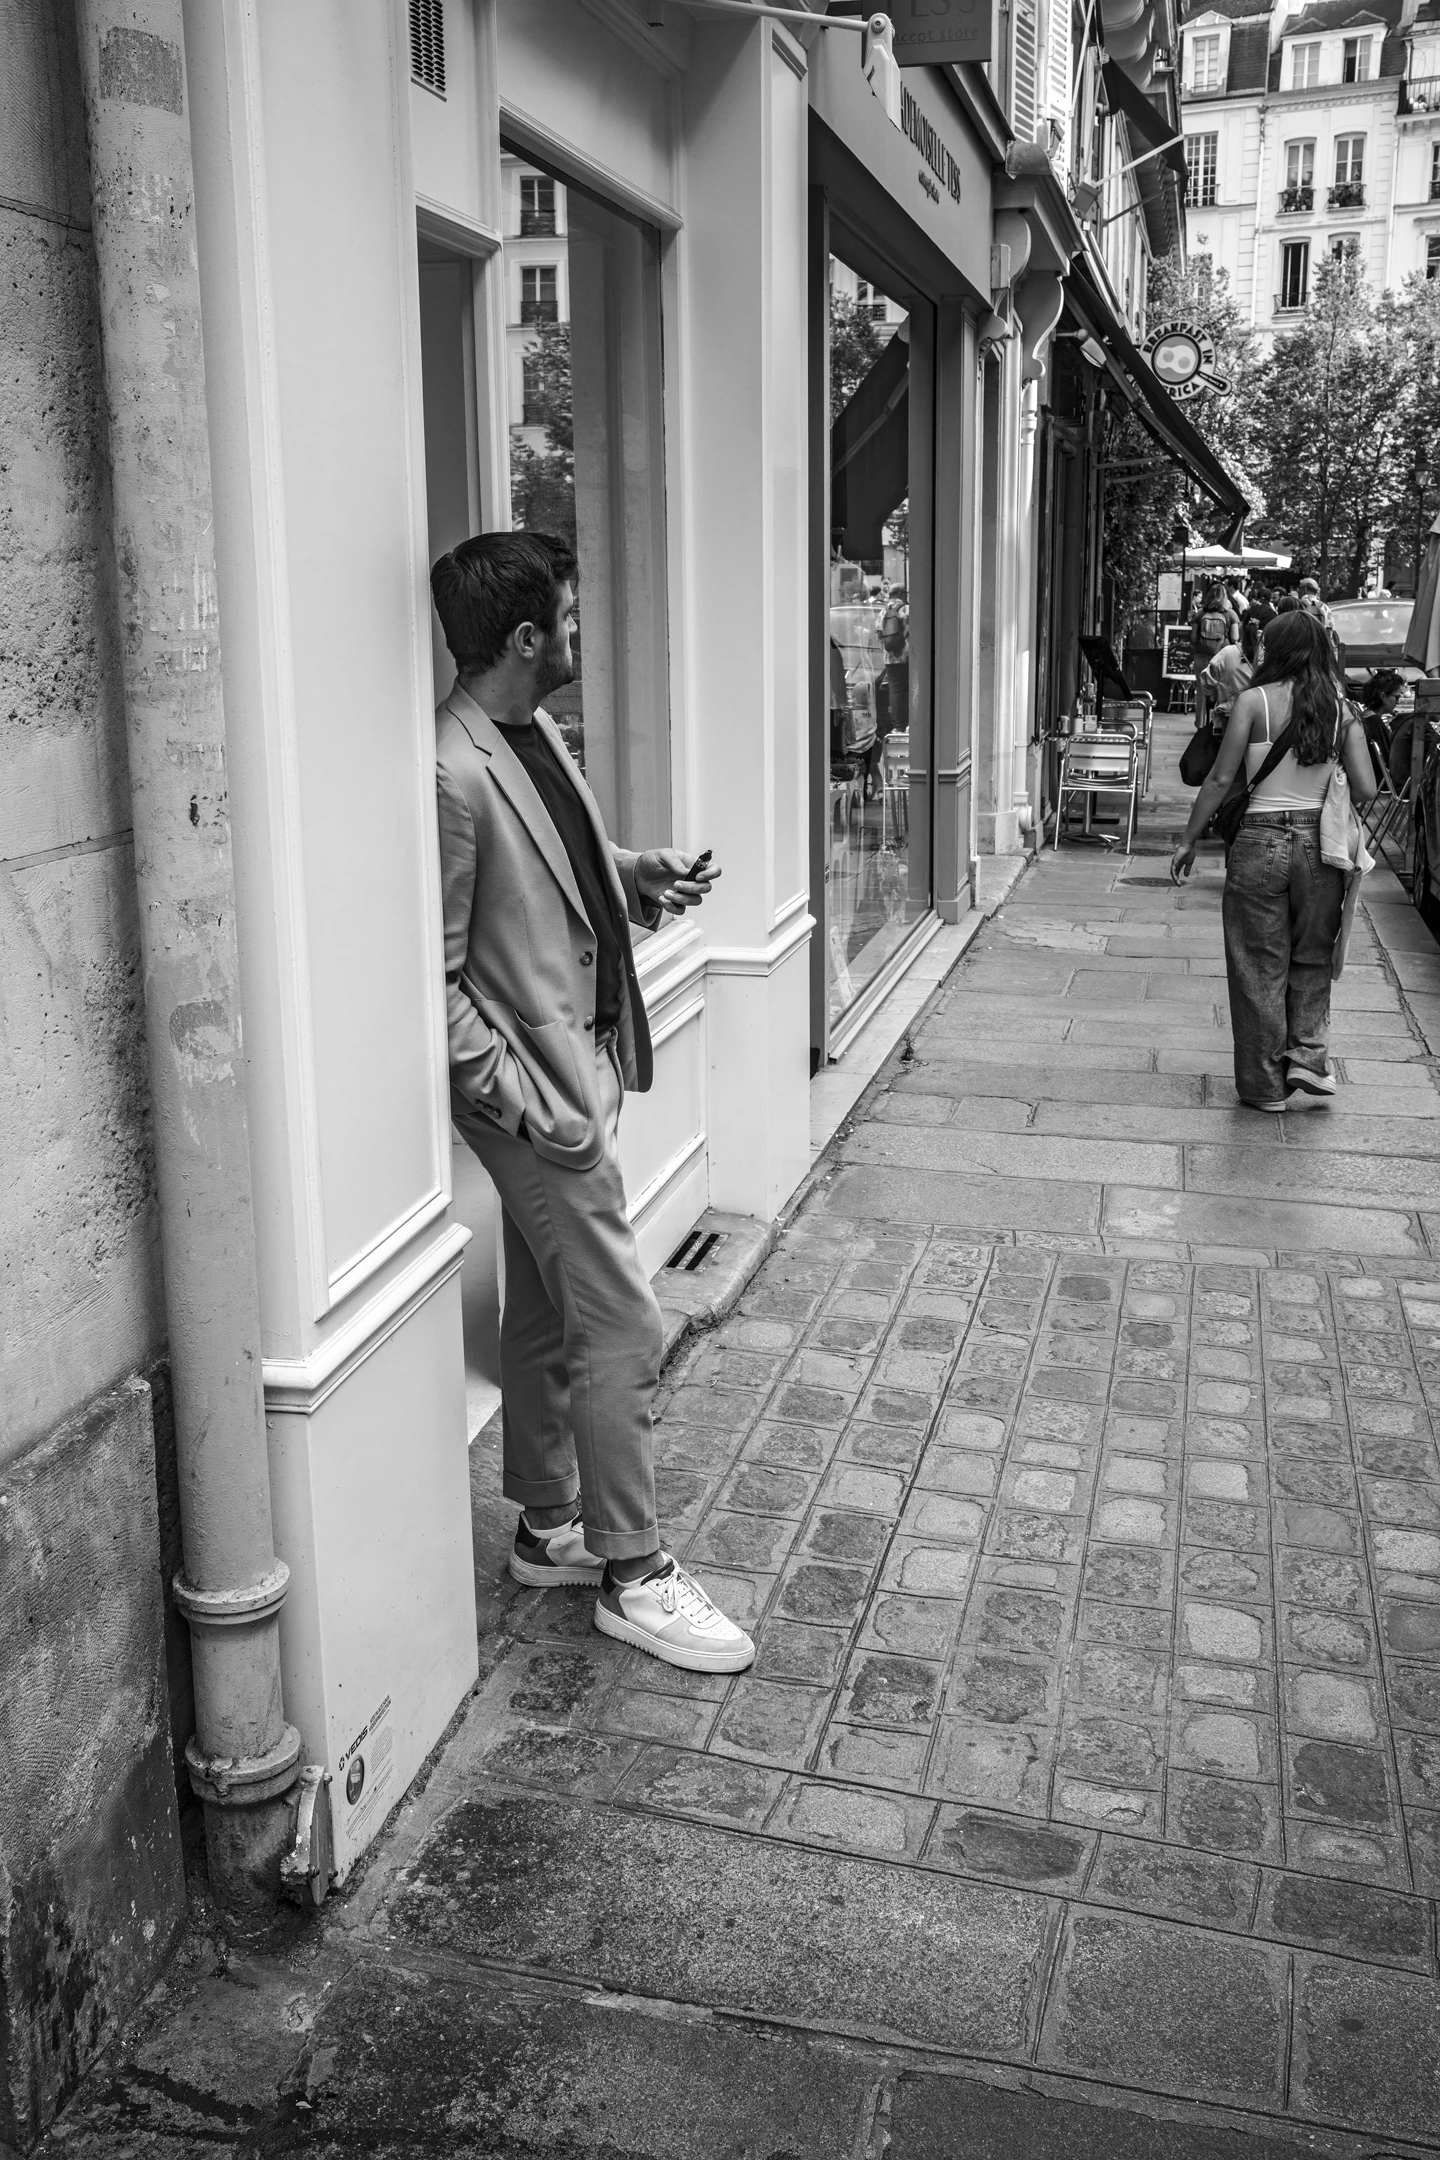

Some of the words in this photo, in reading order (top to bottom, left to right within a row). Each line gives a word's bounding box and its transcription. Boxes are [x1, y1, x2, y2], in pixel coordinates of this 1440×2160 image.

[940, 27, 979, 39] store
[945, 149, 961, 205] TESS
[1143, 323, 1208, 354] BREAKFAST
[1202, 349, 1214, 365] IN
[345, 1724, 368, 1760] VEDIS
